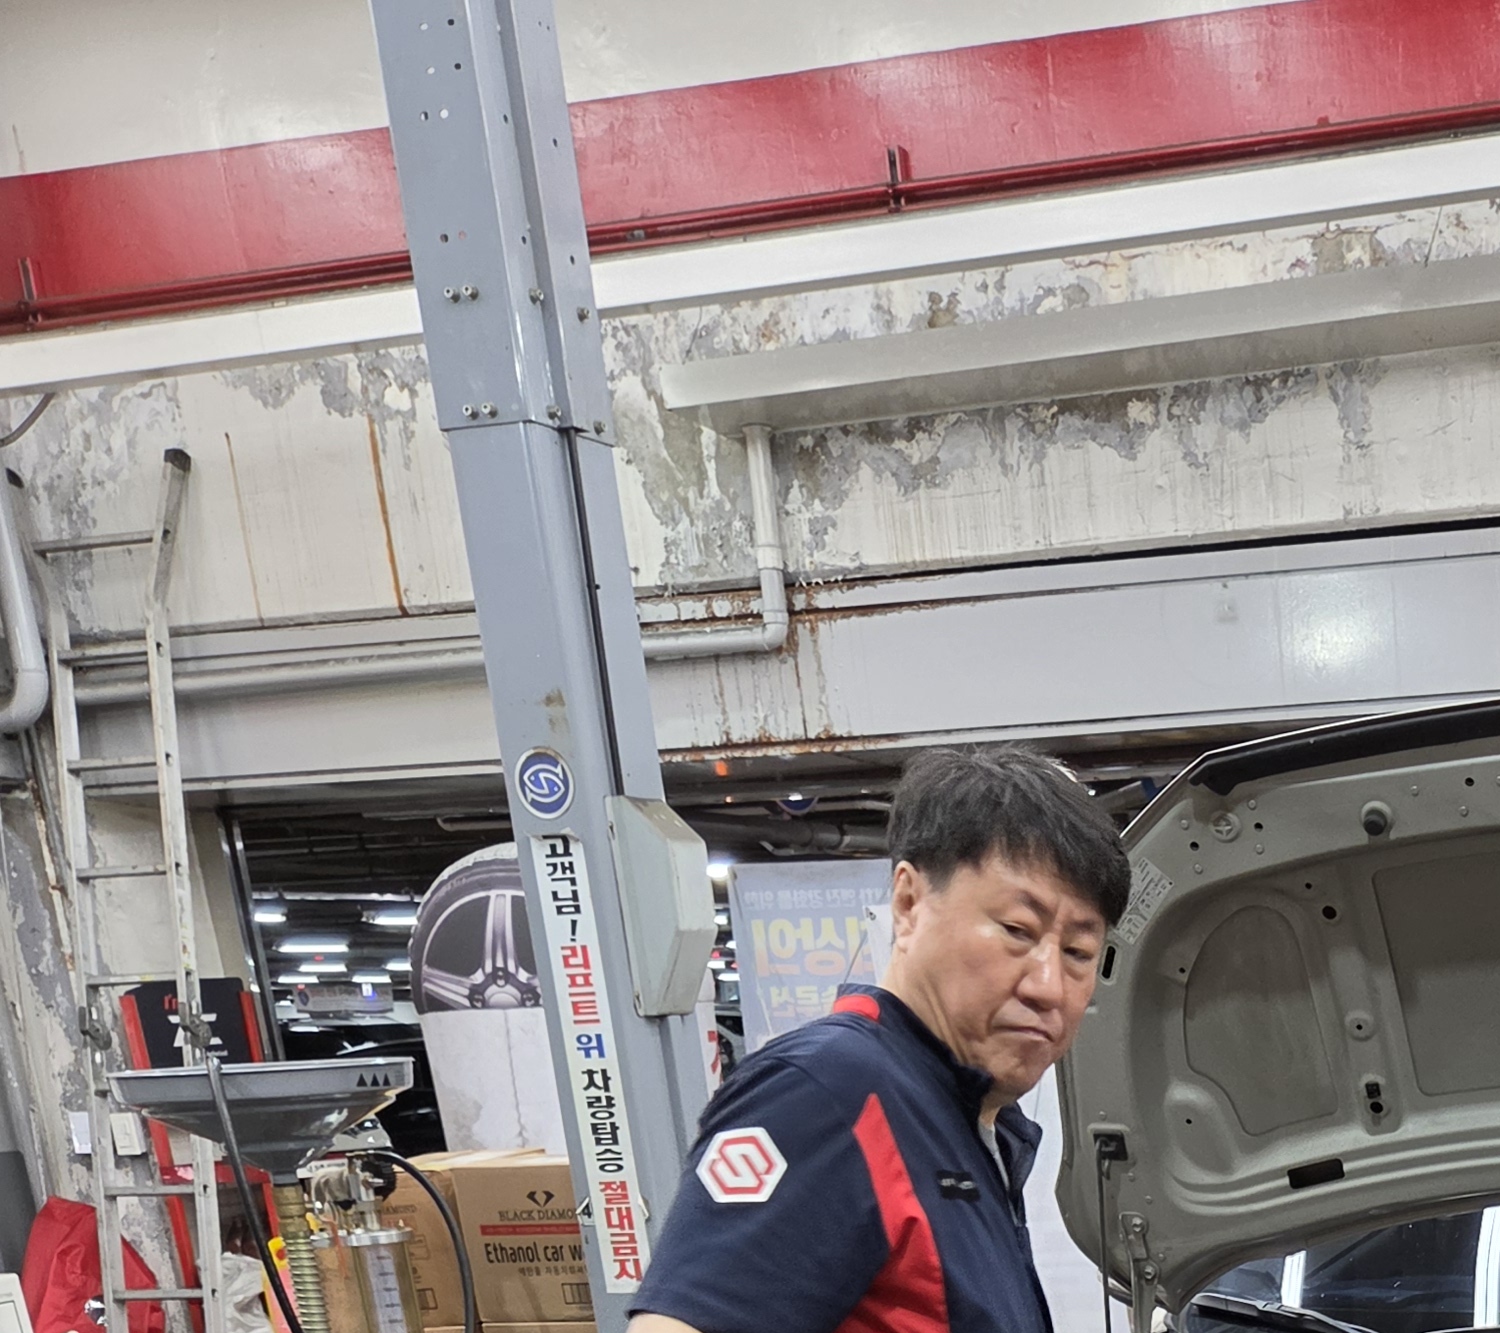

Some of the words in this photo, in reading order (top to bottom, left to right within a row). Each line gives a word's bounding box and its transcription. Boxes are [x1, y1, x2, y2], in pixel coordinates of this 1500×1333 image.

[541, 834, 582, 942] 고객님!
[560, 944, 601, 1025] 리프트
[575, 1032, 607, 1059] 위
[580, 1068, 624, 1173] 차량탑승
[484, 1241, 541, 1264] Ethanol
[543, 1245, 565, 1262] car
[498, 1209, 535, 1221] BLACK
[537, 1207, 577, 1221] DIAMO
[598, 1180, 643, 1282] 절대금지
